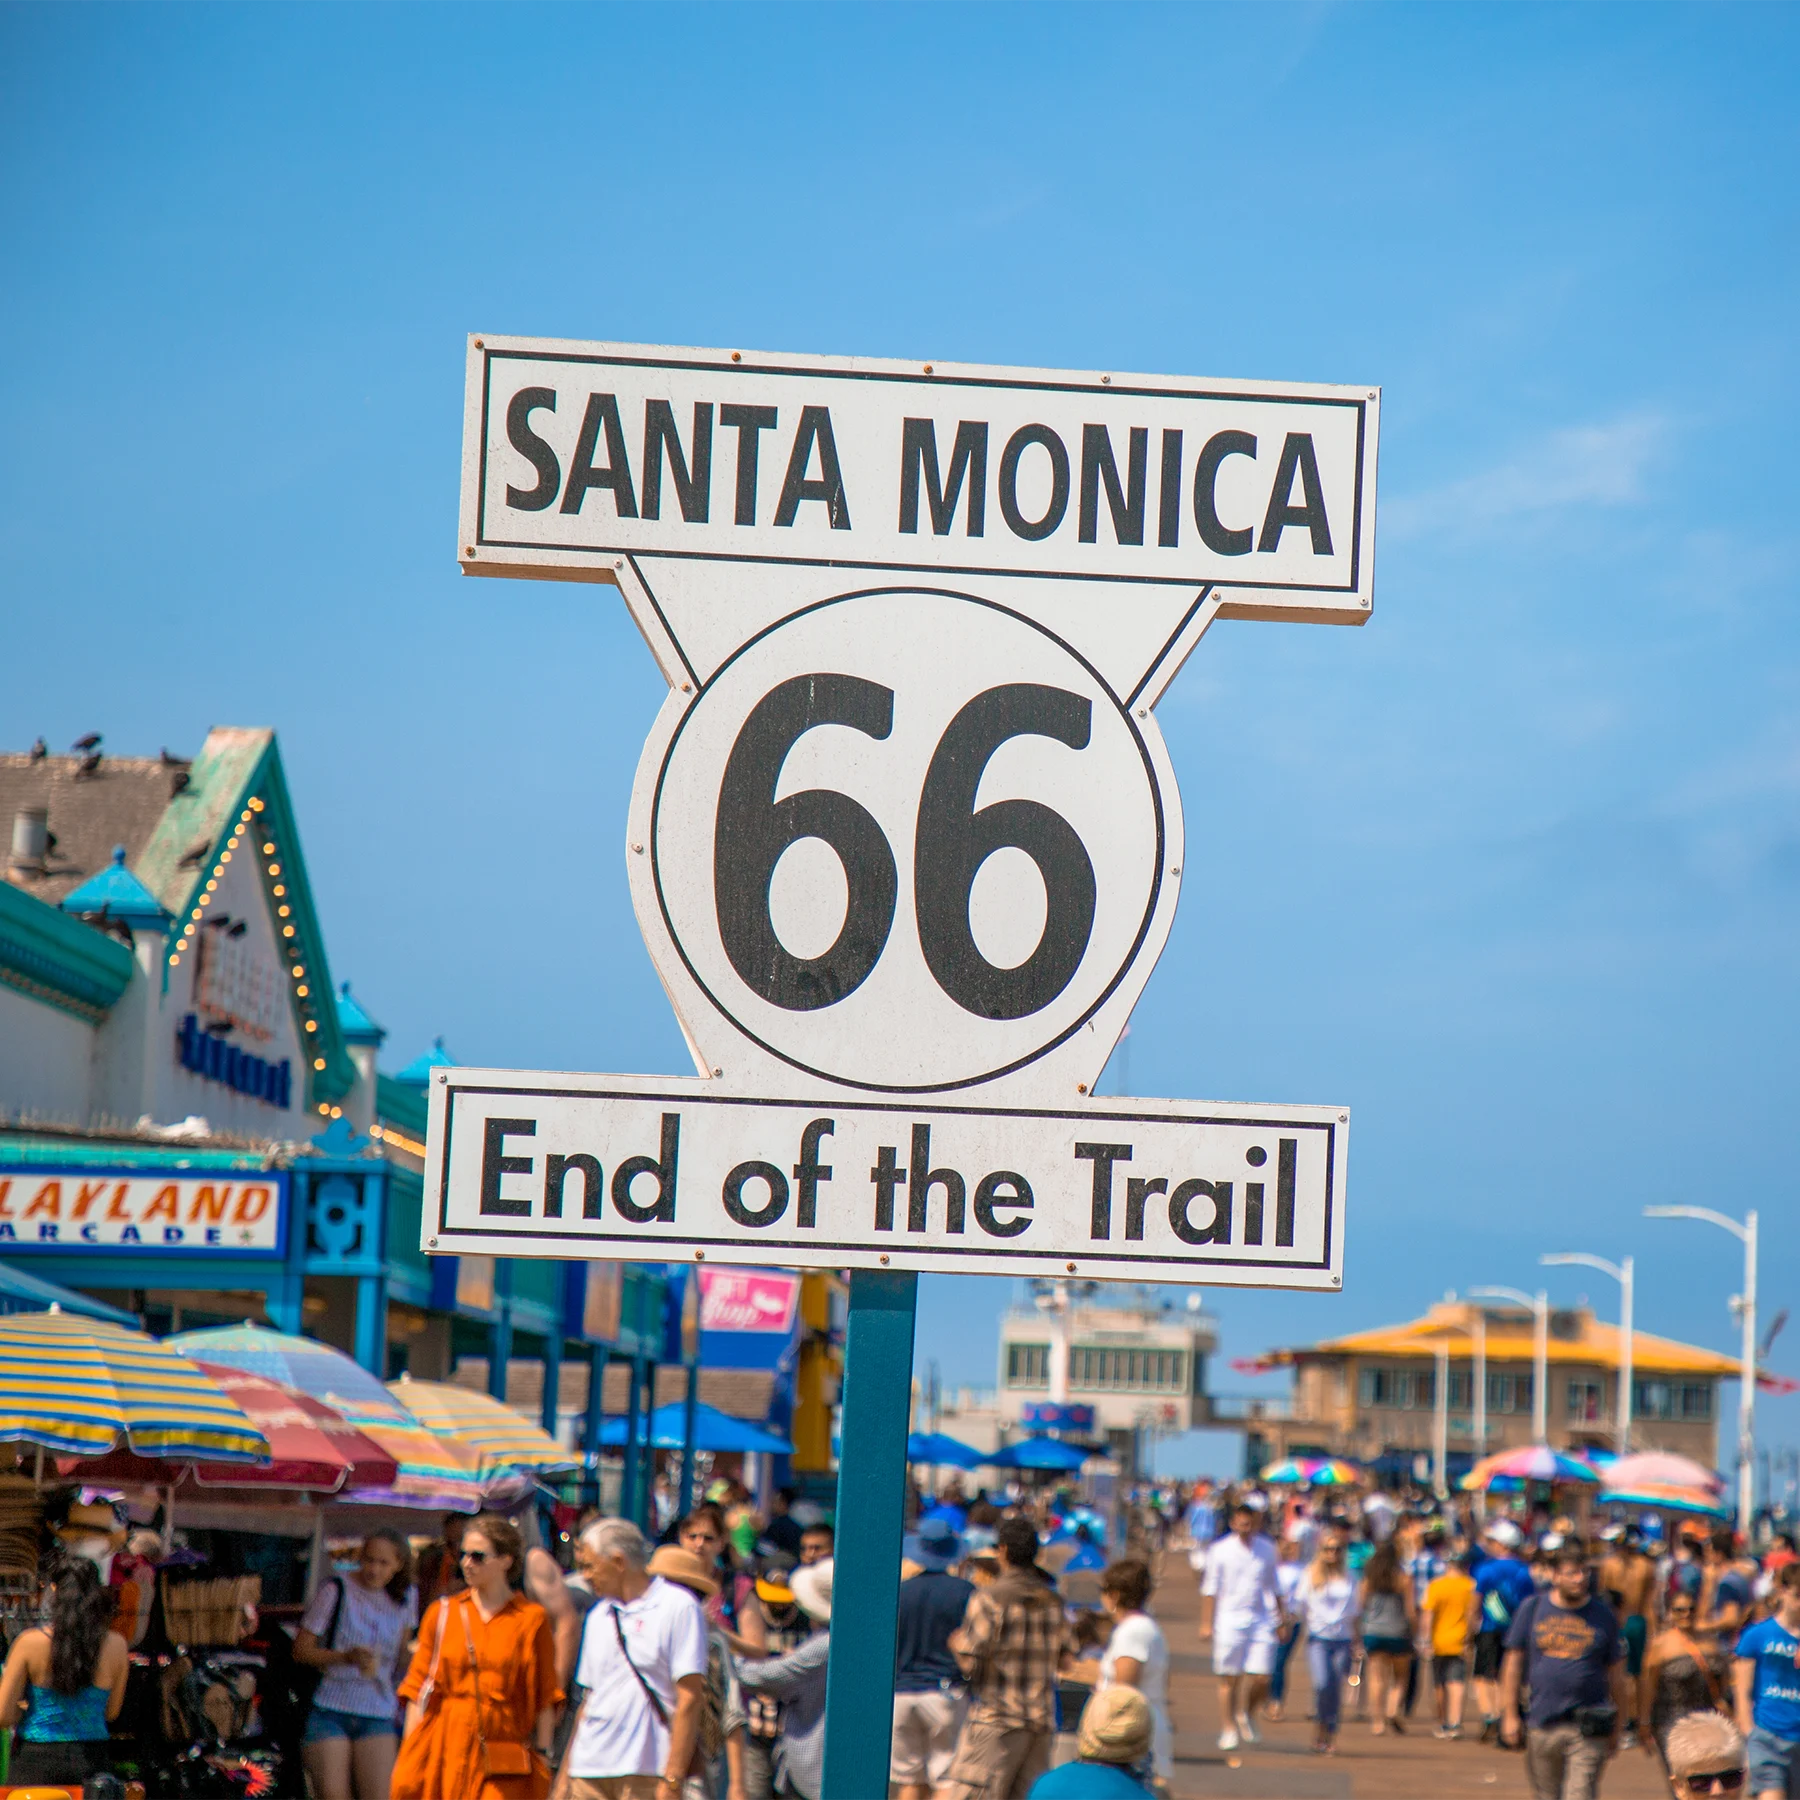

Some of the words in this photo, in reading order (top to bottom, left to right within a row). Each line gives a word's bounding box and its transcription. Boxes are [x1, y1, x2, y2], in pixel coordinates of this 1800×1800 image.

[505, 386, 852, 531] SANTA
[898, 416, 1335, 557] MONICA
[713, 672, 1098, 1021] 66
[0, 1222, 222, 1247] ARCADE
[479, 1112, 681, 1224] End
[722, 1117, 835, 1229] of
[870, 1122, 1035, 1238] the
[1074, 1138, 1298, 1248] Trail
